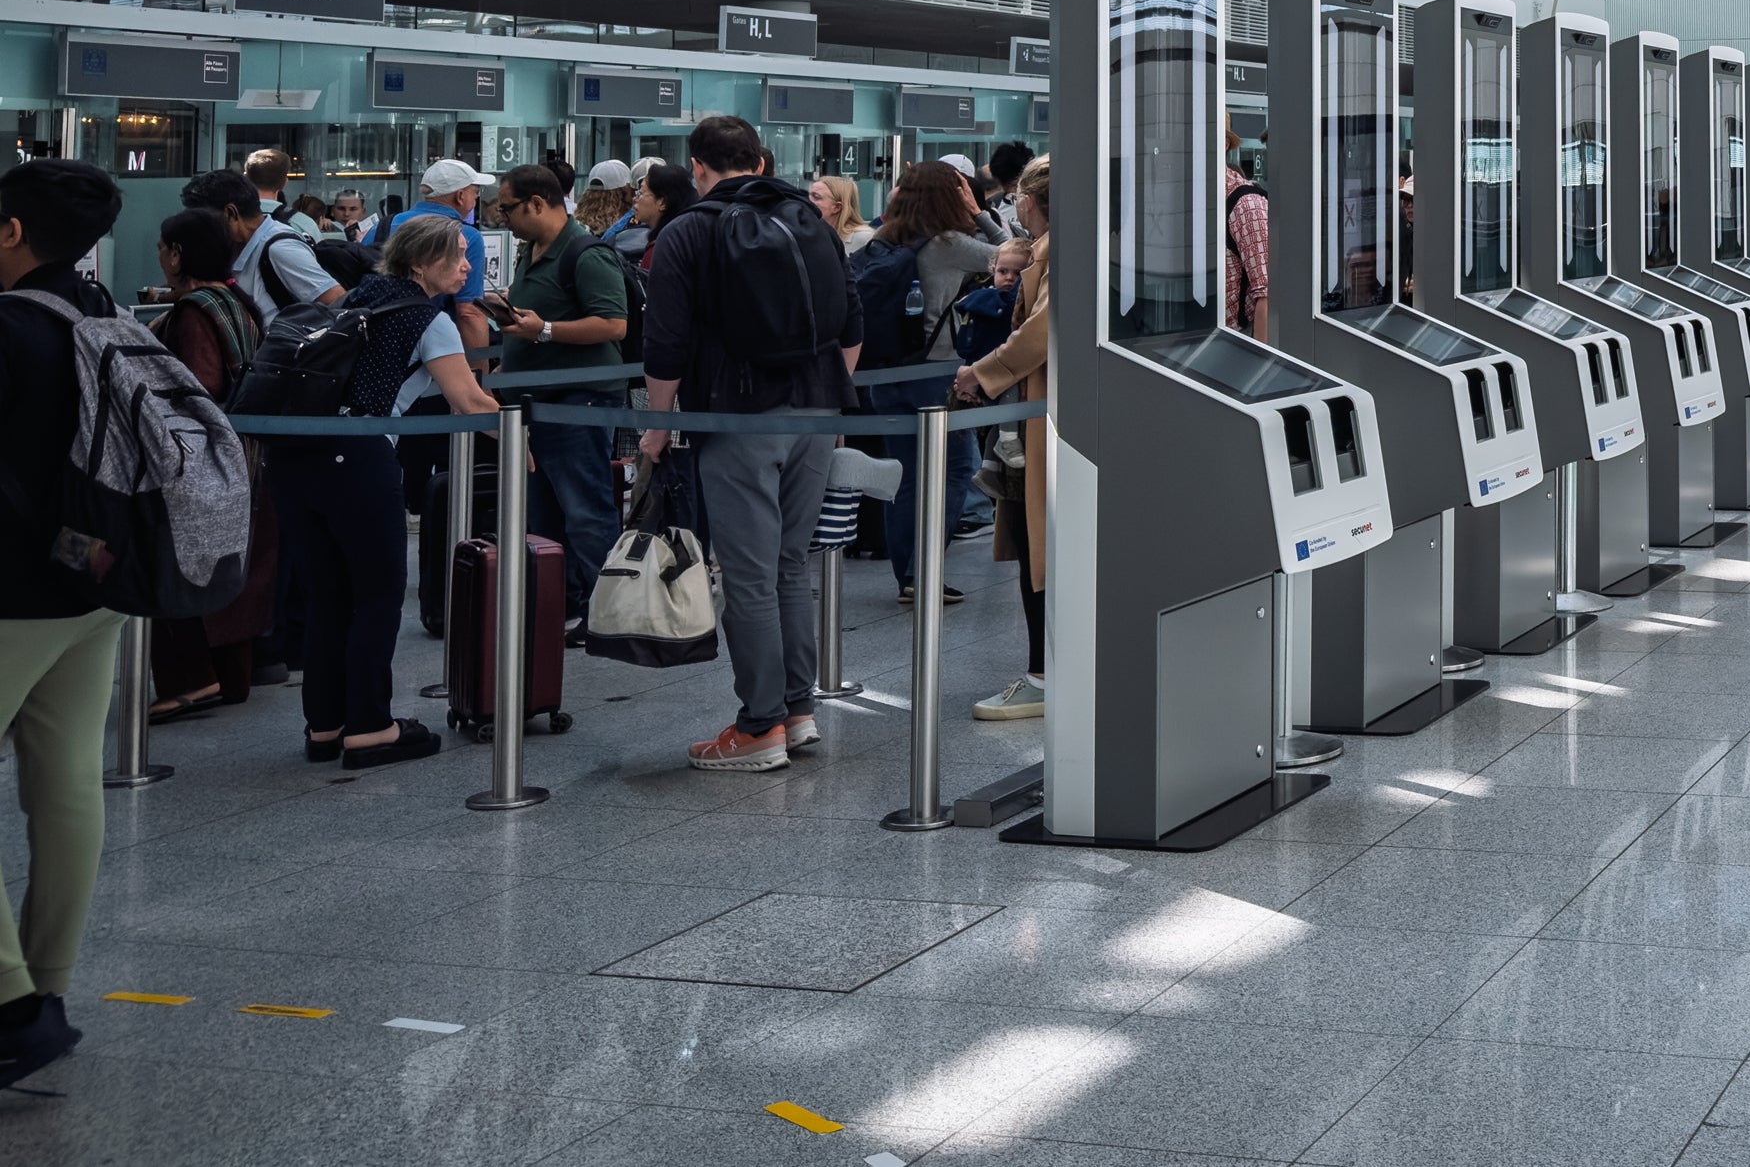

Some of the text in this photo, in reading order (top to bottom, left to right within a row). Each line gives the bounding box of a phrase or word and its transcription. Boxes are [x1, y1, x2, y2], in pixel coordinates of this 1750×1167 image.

[749, 17, 762, 39] H,
[765, 19, 772, 38] L
[501, 137, 515, 162] 3
[844, 145, 855, 166] 4
[1351, 522, 1373, 537] secunet
